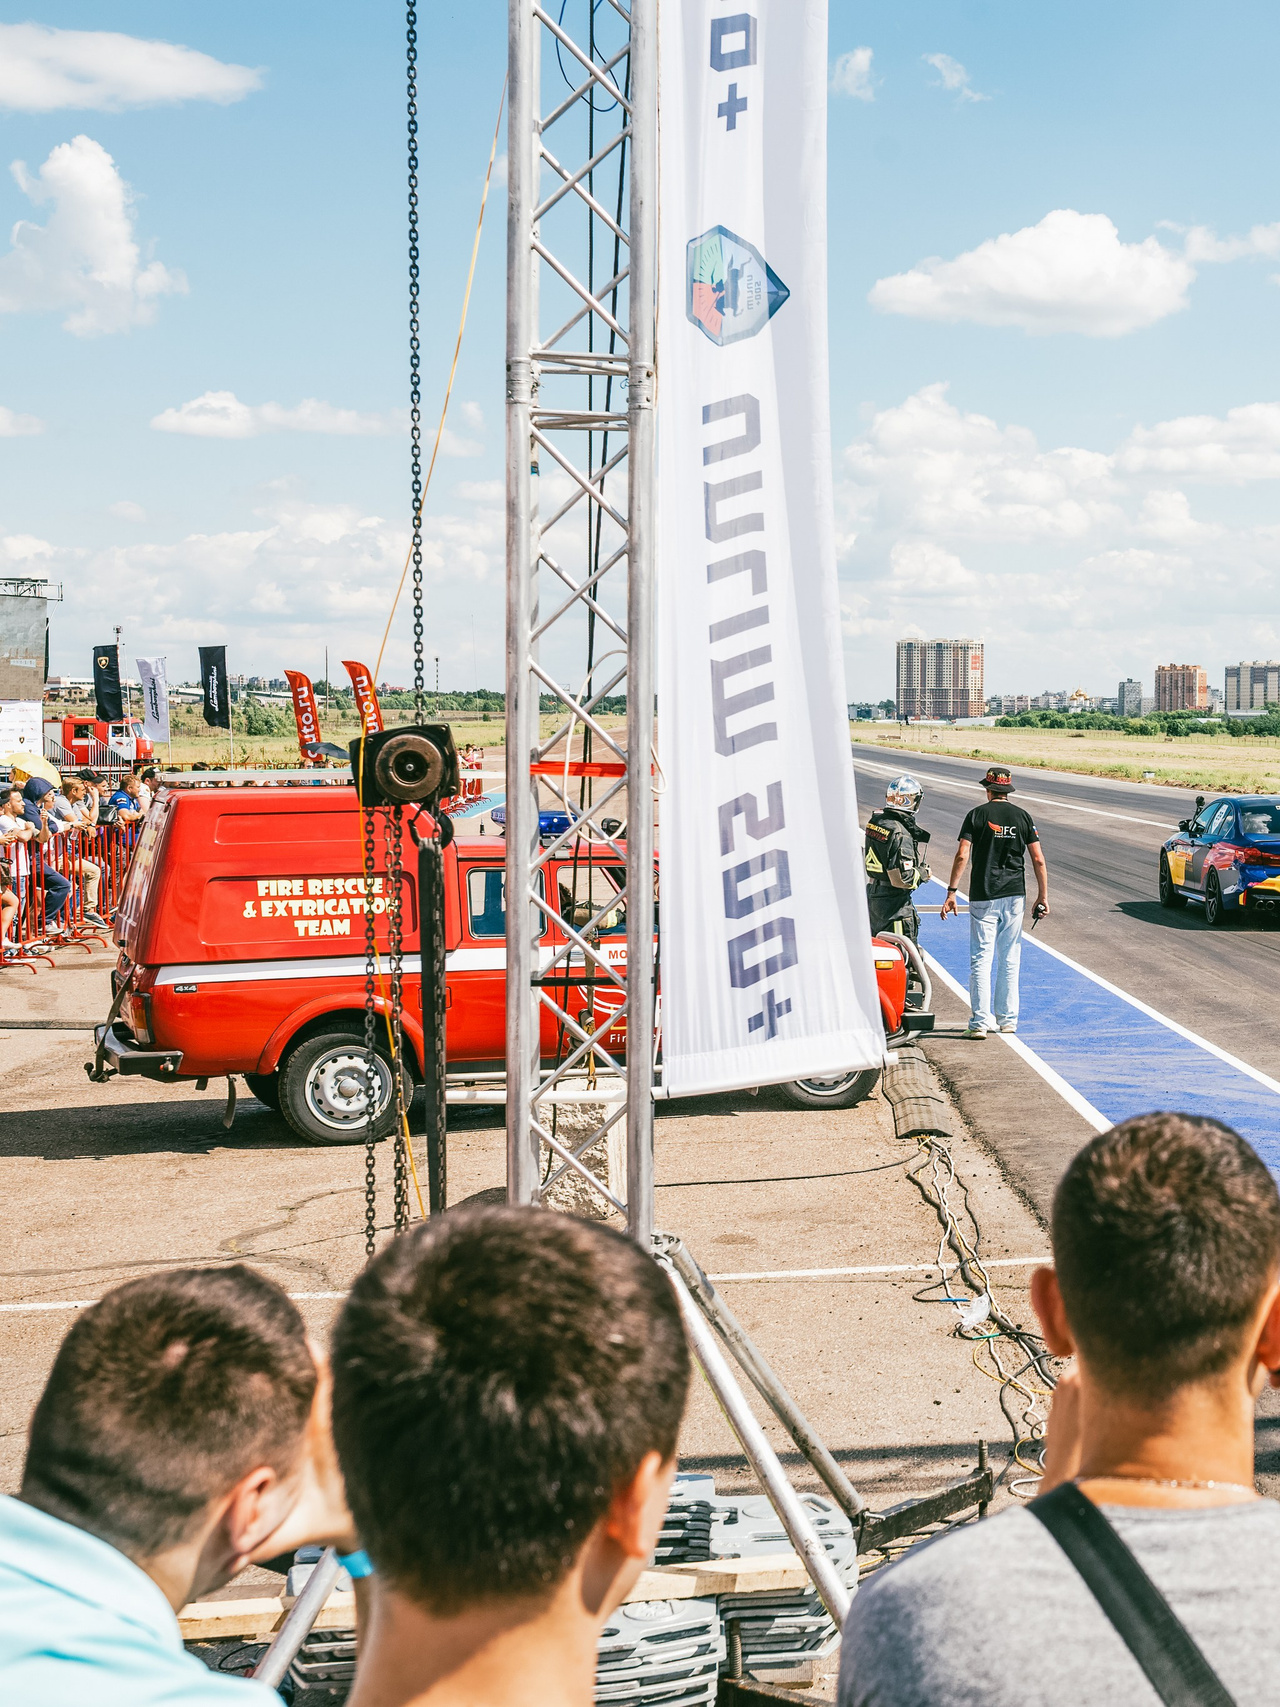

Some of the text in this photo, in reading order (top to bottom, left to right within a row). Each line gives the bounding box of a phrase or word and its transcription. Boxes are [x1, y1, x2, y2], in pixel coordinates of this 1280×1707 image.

[356, 675, 380, 734] uto.ru
[257, 879, 304, 897] FIRE
[242, 901, 257, 918] &
[294, 919, 351, 937] TEAM
